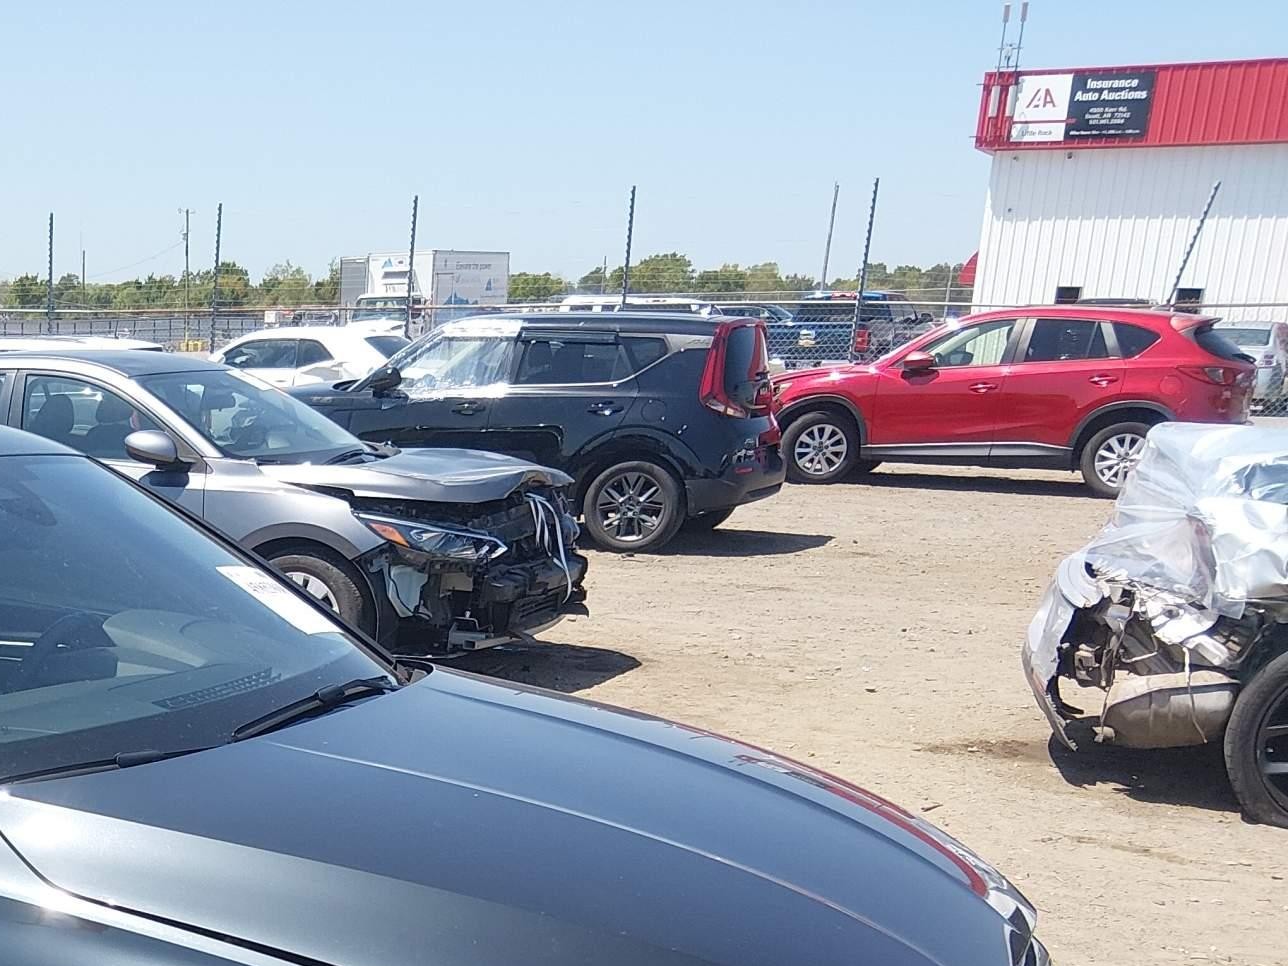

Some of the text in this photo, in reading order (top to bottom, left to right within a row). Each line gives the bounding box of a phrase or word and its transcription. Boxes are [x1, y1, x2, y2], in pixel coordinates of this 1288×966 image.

[1086, 78, 1139, 89] Insurance
[1074, 89, 1148, 102] Auto Auctions
